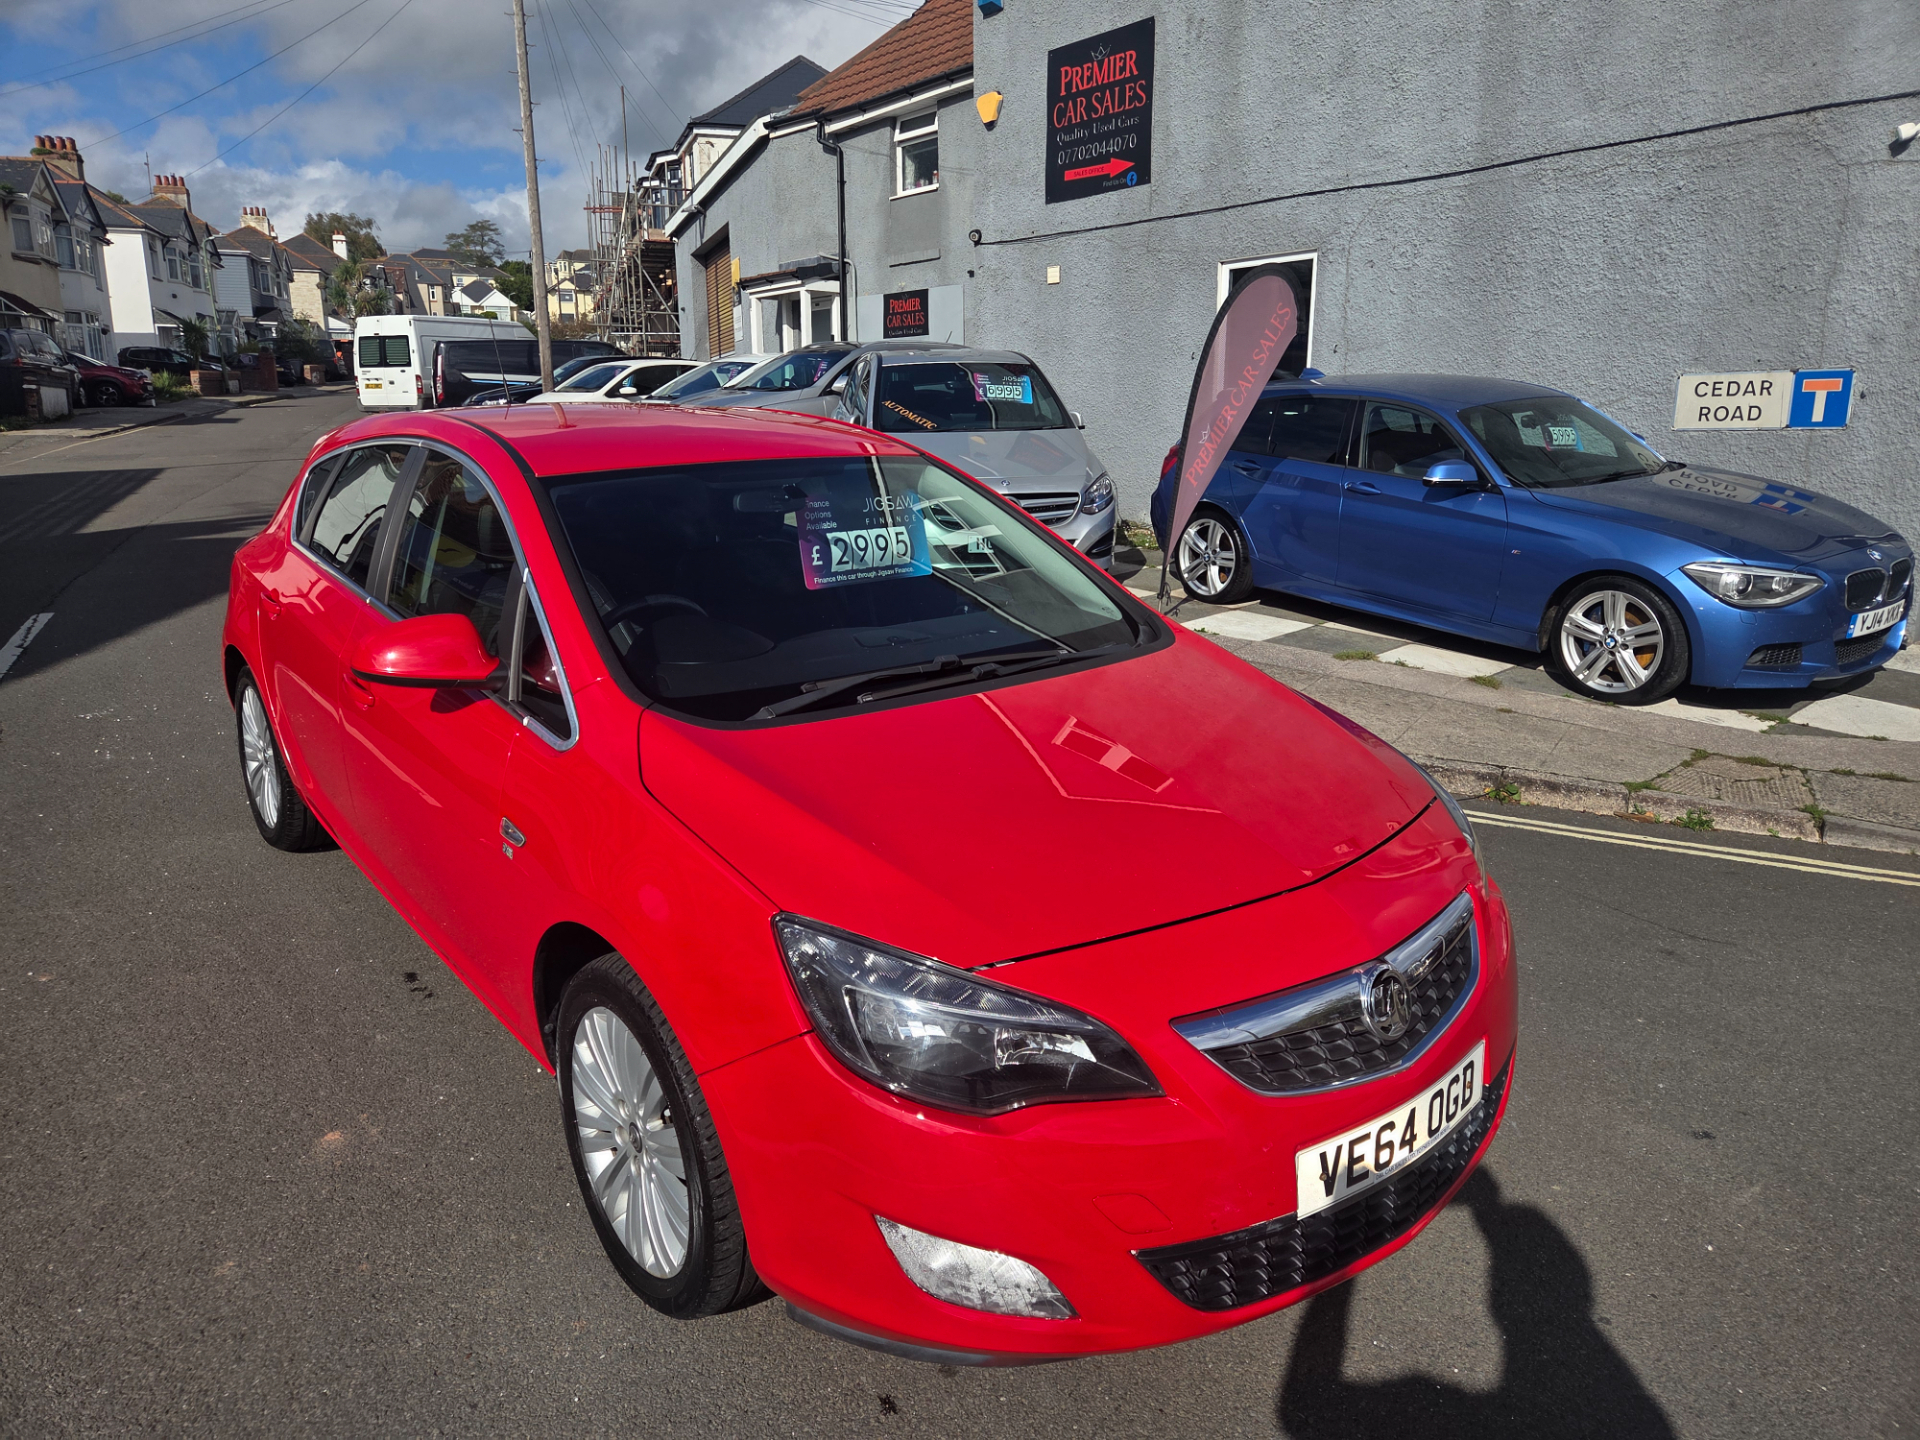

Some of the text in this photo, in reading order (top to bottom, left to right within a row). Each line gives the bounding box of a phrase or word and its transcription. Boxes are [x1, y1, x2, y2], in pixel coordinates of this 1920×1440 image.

[1060, 50, 1138, 96] PREMIER
[1053, 80, 1146, 128] CAR SALES
[1056, 115, 1139, 146] Quality Used Cars
[1058, 133, 1137, 165] 07702044070
[1074, 169, 1088, 177] SALES
[890, 298, 921, 313] PREMIER
[887, 312, 925, 327] CAR SALES
[988, 386, 1021, 396] 6995
[1186, 302, 1291, 488] PREMIER CAR SALES
[1694, 380, 1773, 398] CEDAR
[882, 400, 938, 430] AUTOMATIC
[1698, 405, 1762, 422] ROAD
[863, 496, 914, 512] JIGSAW
[804, 510, 832, 520] Options
[866, 515, 917, 525] FINANCE
[806, 521, 837, 530] Available
[811, 532, 908, 566] £ 2995
[814, 576, 836, 584] Finance
[857, 570, 877, 580] through
[878, 569, 894, 577] Jigsaw
[1860, 610, 1885, 632] YJ14
[1319, 1060, 1474, 1198] VE64 OGD
